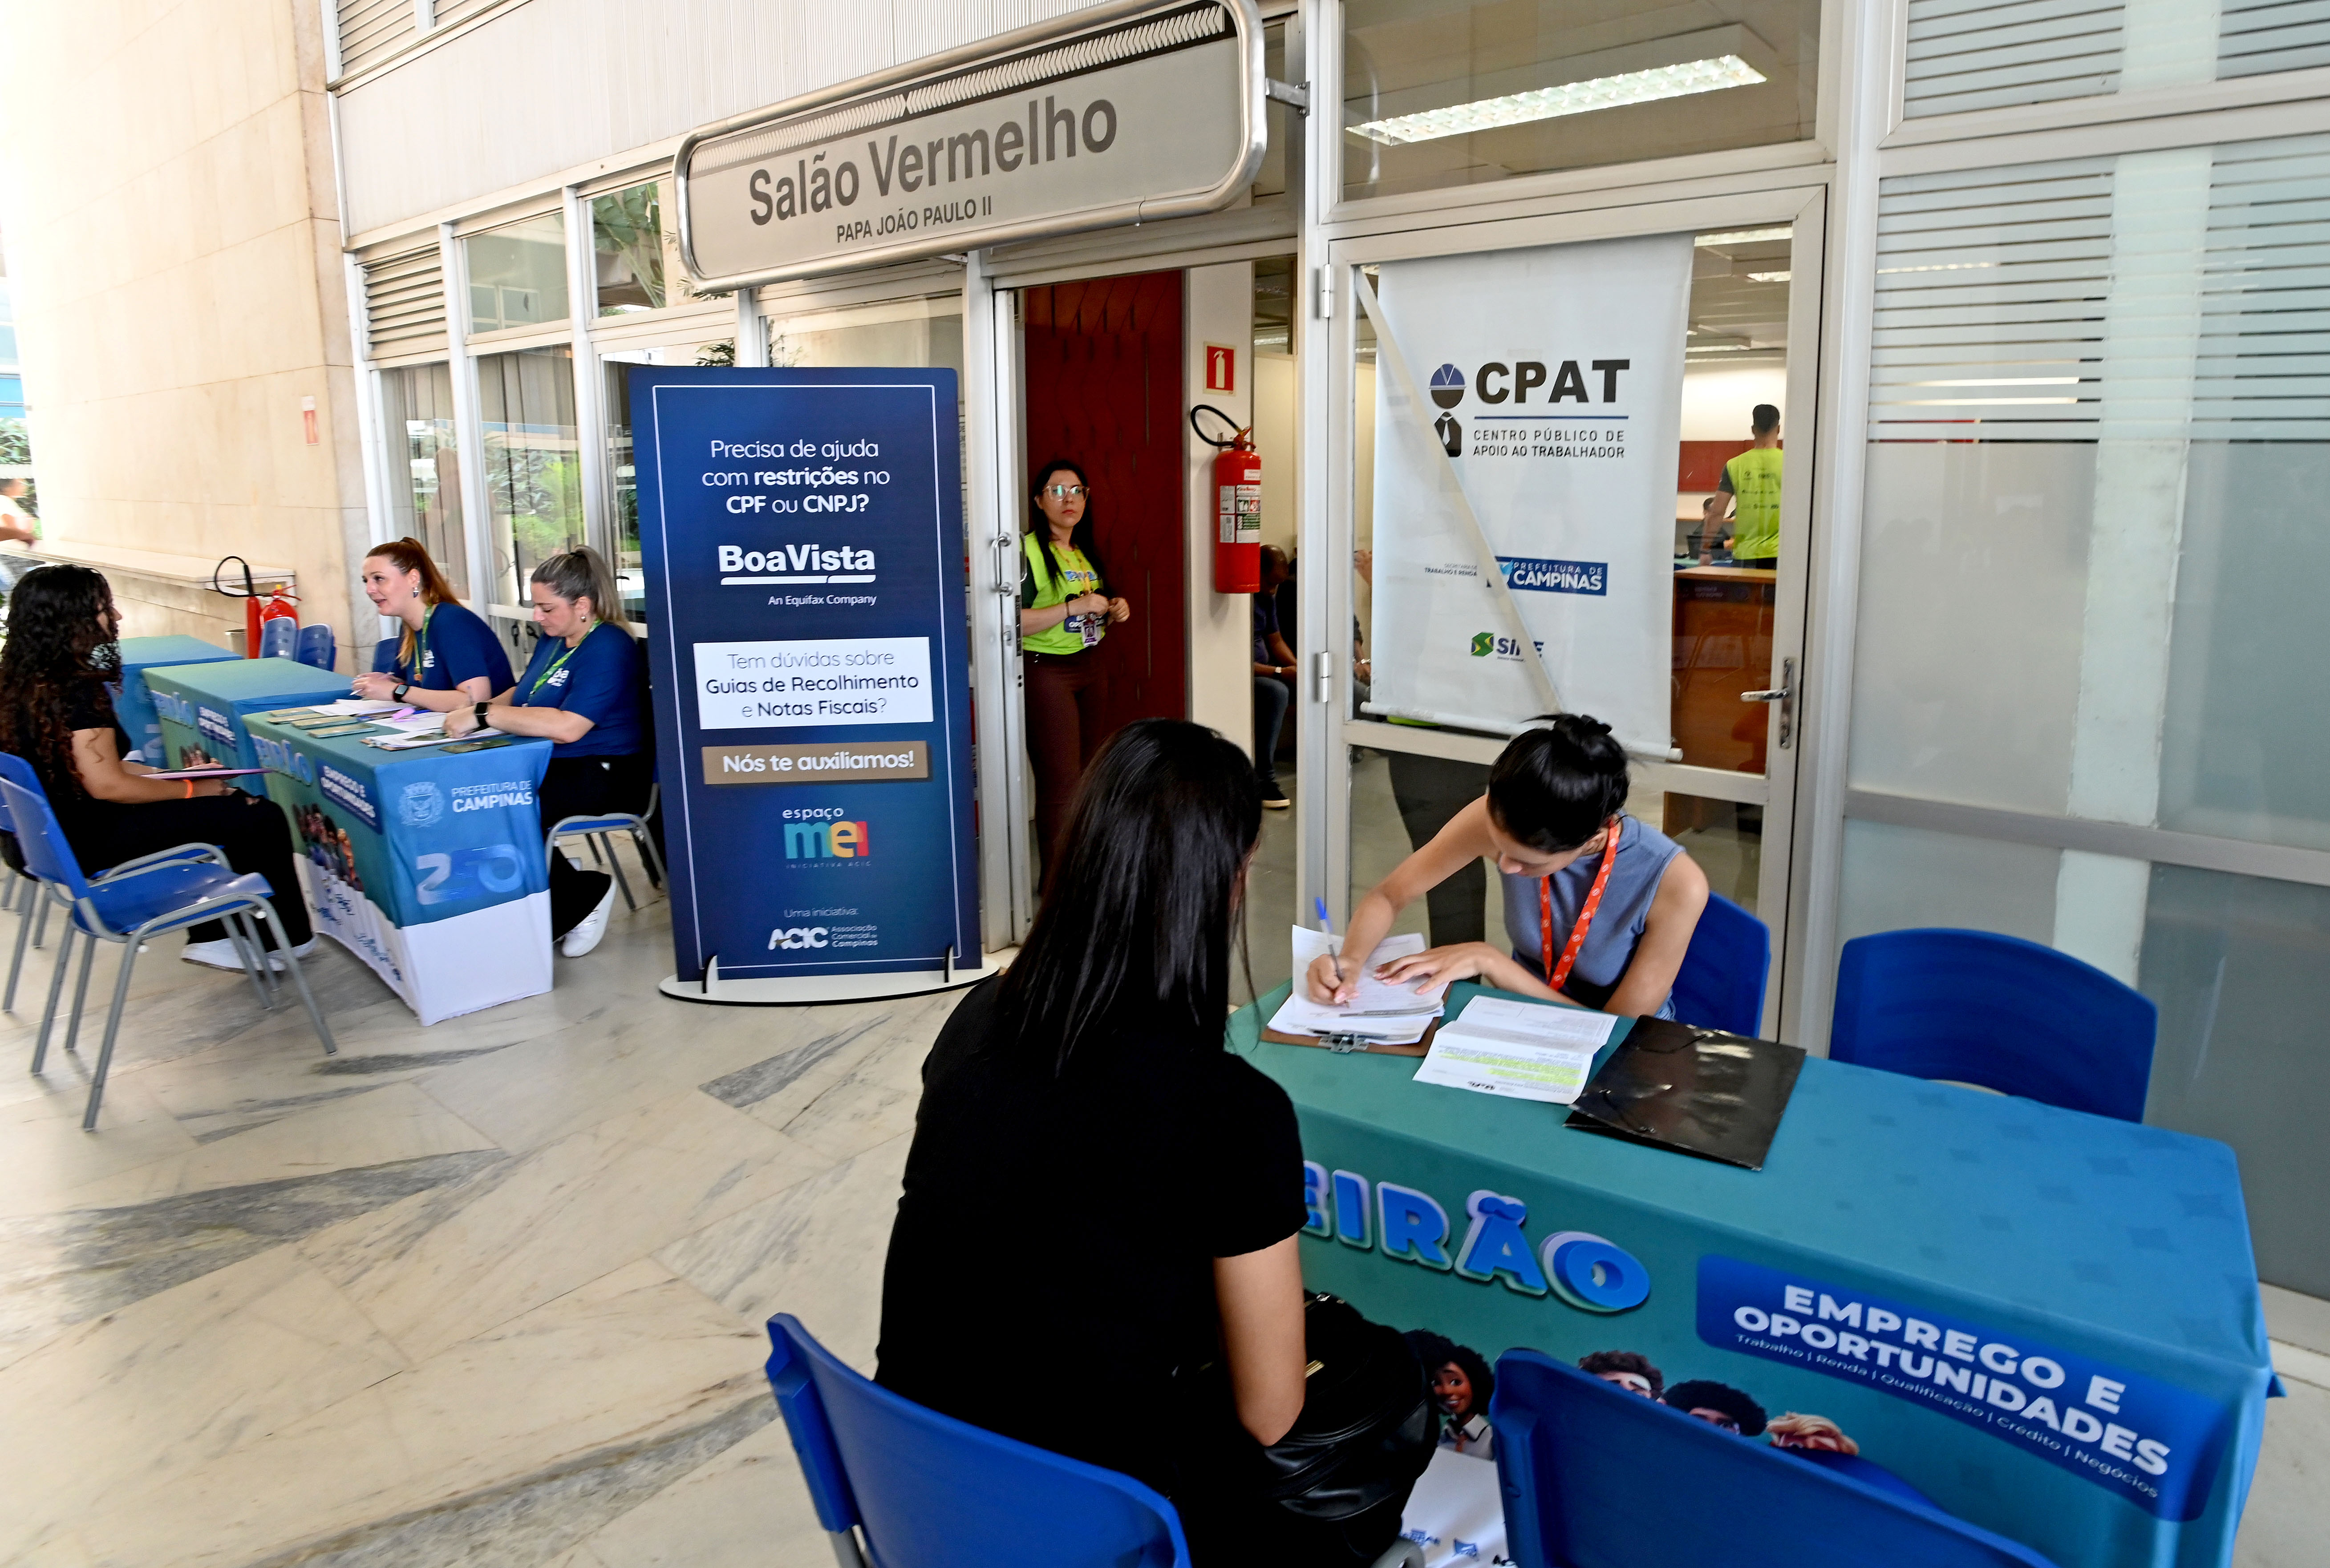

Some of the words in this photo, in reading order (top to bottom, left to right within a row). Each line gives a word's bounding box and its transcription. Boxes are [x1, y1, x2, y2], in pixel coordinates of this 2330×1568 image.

[750, 151, 859, 226] Salão
[868, 96, 1117, 198] Vermelho
[837, 222, 872, 243] PAPA
[877, 208, 919, 237] JOÃO
[924, 199, 977, 227] PAULO
[982, 196, 992, 216] II
[1476, 359, 1630, 404] CPAT
[1474, 429, 1527, 441] CENTRO
[1534, 427, 1597, 442] PÚBLICO
[1606, 430, 1625, 442] DE
[711, 440, 784, 458] Precisa
[790, 440, 816, 458] de
[821, 439, 878, 461] ajuda
[1473, 445, 1508, 457] APOIO
[1511, 445, 1527, 457] AO
[1532, 445, 1625, 459] TRABALHADOR
[702, 472, 749, 486] com
[754, 466, 859, 488] restrições
[864, 470, 890, 485] no
[726, 496, 767, 513] CPF
[772, 499, 798, 513] ou
[803, 494, 870, 513] CNPJ?
[718, 544, 875, 572] BoaVista
[1514, 562, 1582, 575] PREFEITURA
[1589, 566, 1603, 575] DE
[1513, 573, 1602, 591] CAMPINAS
[768, 596, 783, 605] An
[786, 594, 825, 607] Equifax
[827, 594, 877, 606] Company
[727, 654, 766, 669] Tem
[770, 651, 841, 668] dúvidas
[845, 650, 895, 666] sobre
[706, 678, 757, 695] Guias
[763, 677, 786, 692] de
[792, 674, 919, 691] Recolhimento
[742, 704, 753, 717] e
[758, 701, 813, 717] Notas
[819, 697, 887, 715] Fiscais?
[723, 754, 766, 773] Nós
[770, 754, 793, 772] te
[797, 750, 915, 771] auxiliamos!
[452, 782, 518, 797] PREFEITURA
[520, 780, 531, 790] DE
[452, 792, 533, 813] CAMPINAS
[782, 807, 844, 820] espaço
[784, 909, 811, 917] Uma
[768, 927, 828, 950] ACIC
[831, 924, 878, 933] Associação
[832, 940, 878, 948] Campinas
[1784, 1285, 2066, 1389] EMPREGO
[2086, 1374, 2126, 1414] E
[1734, 1306, 2170, 1477] OPORTUNIDADES
[1736, 1334, 1803, 1358] Trabalho
[1816, 1354, 1867, 1378] Renda
[1880, 1374, 1985, 1418] Qualificação
[1997, 1413, 2061, 1451] Crédito
[2075, 1451, 2158, 1499] Negócios
